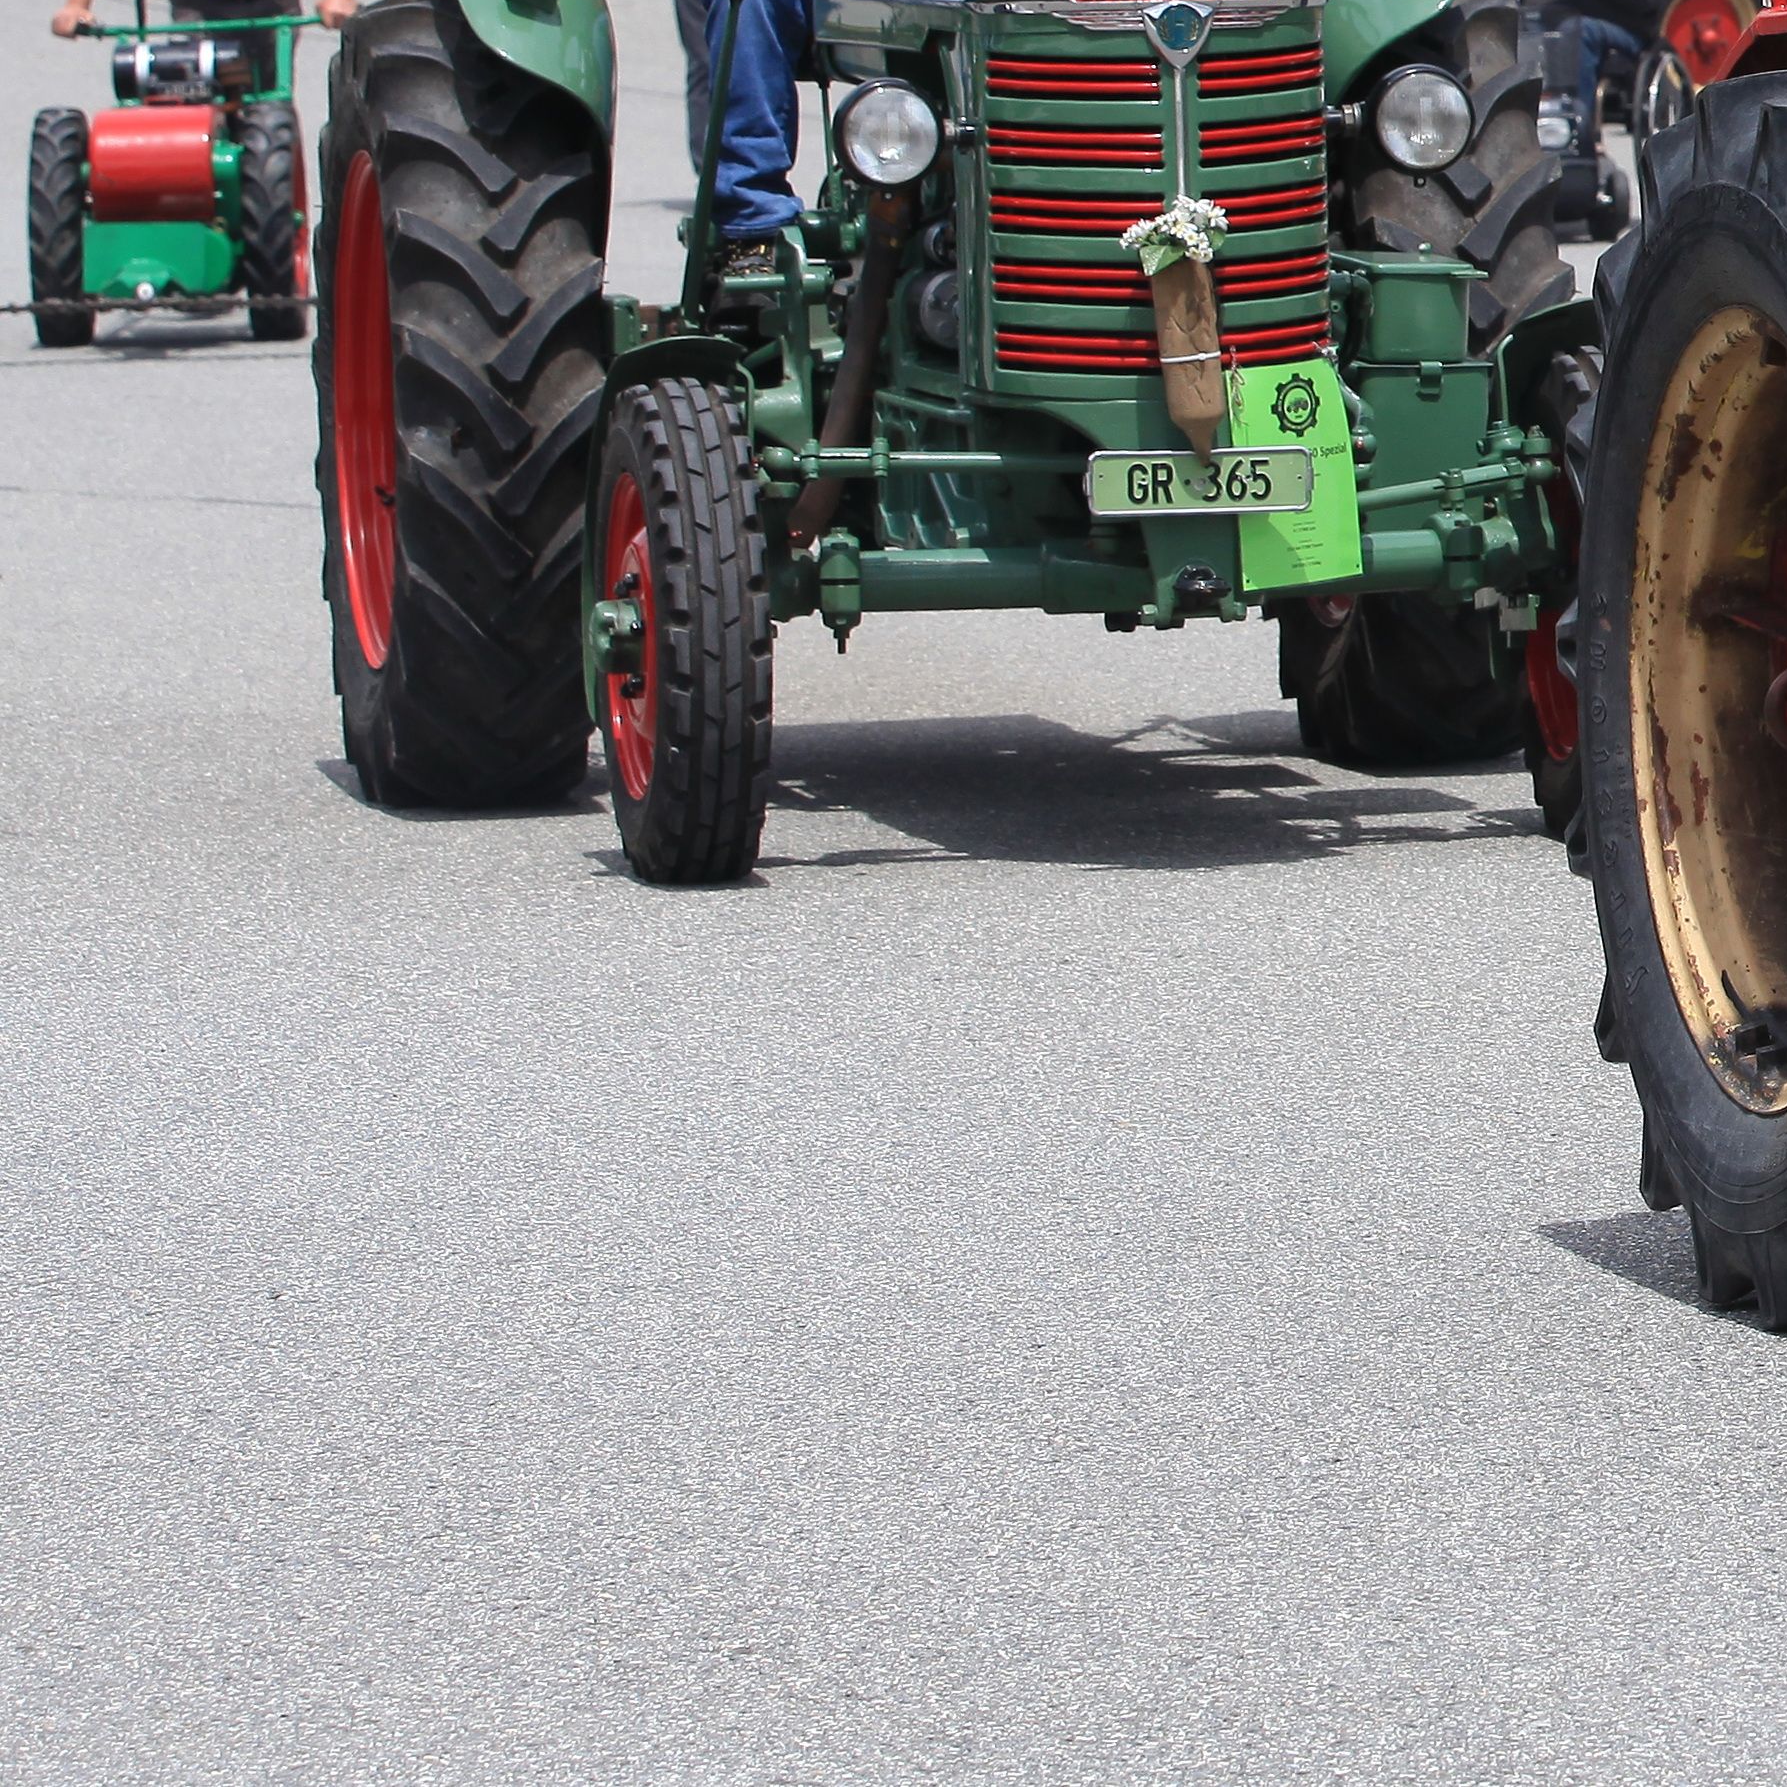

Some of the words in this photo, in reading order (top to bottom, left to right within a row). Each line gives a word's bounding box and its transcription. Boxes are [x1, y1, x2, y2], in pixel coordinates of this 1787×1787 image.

[1319, 442, 1347, 459] Spezial
[1126, 462, 1175, 504] GR
[1202, 458, 1273, 503] 365
